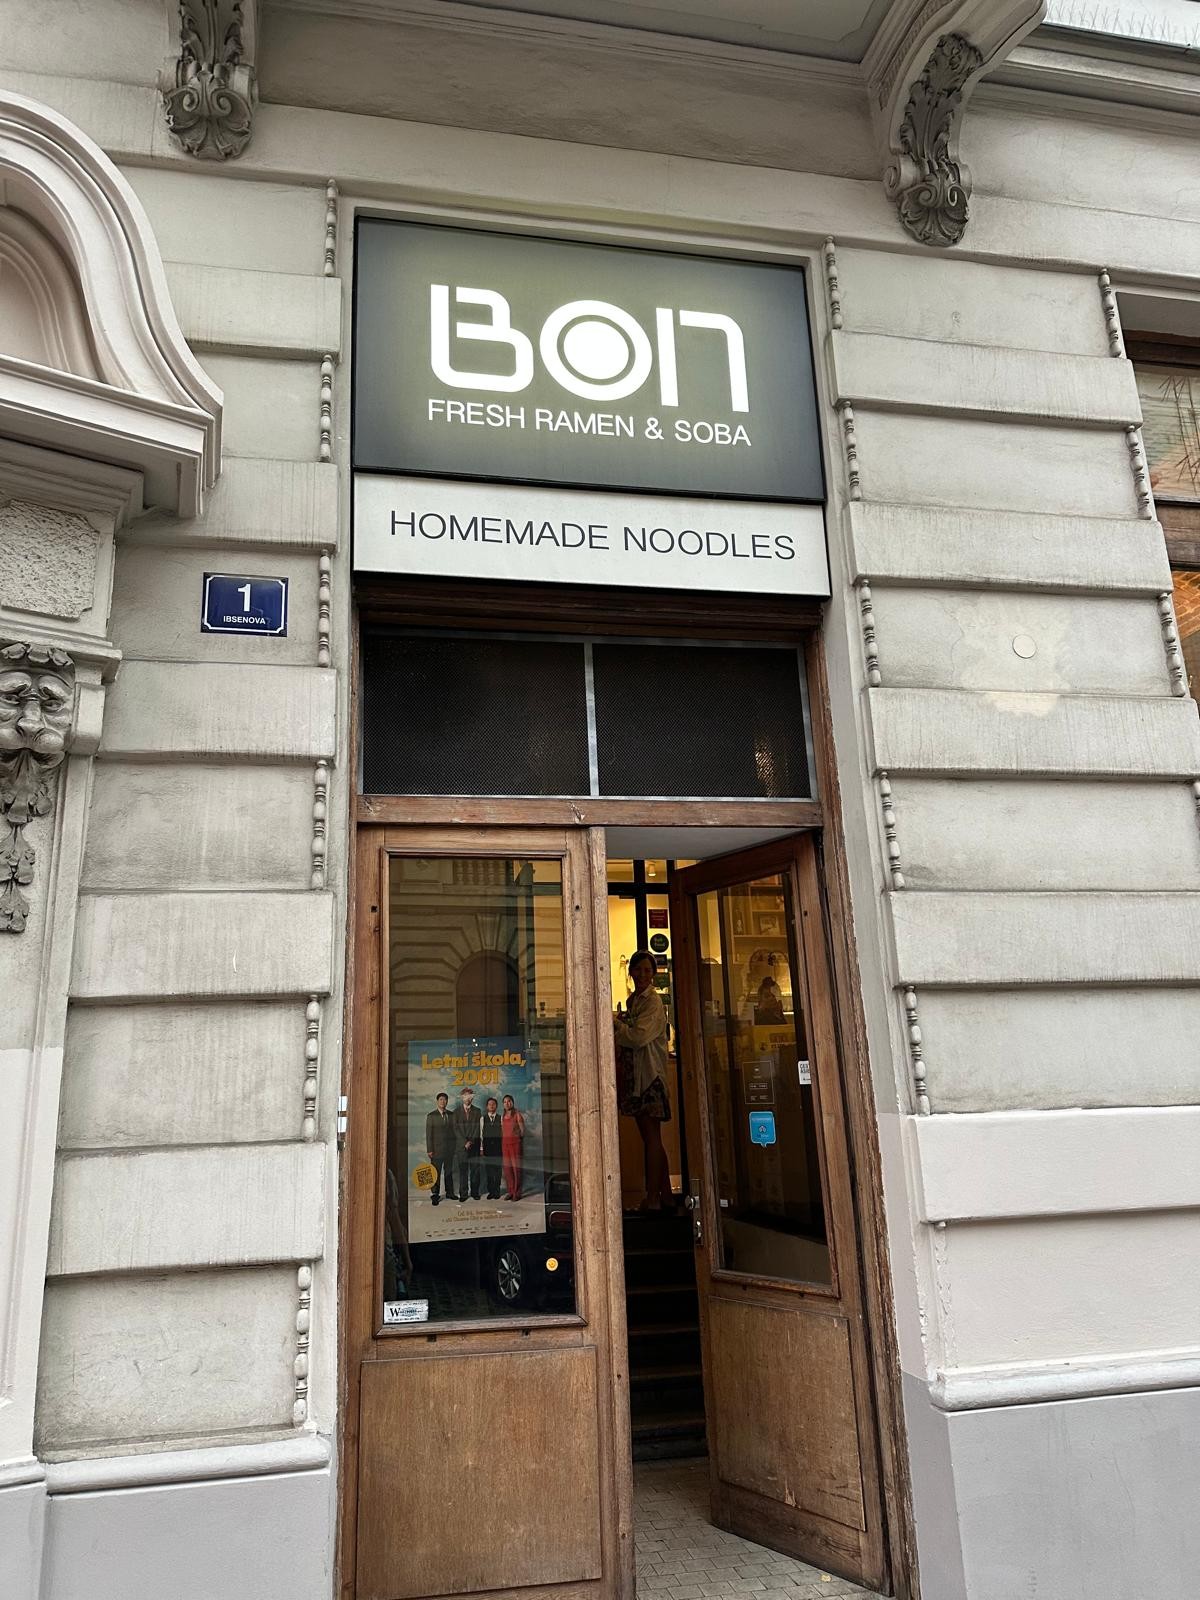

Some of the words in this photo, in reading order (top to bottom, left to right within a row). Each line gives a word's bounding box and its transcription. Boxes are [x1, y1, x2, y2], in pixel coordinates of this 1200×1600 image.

[428, 399, 525, 429] FRESH
[535, 409, 635, 438] RAMEN
[644, 417, 665, 440] &
[674, 420, 752, 447] SOBA
[391, 510, 610, 550] HOMEMADE
[624, 527, 796, 560] NOODLES
[238, 583, 251, 612] 1
[223, 615, 266, 625] IBSENOVA
[421, 1053, 469, 1070] Letní
[472, 1050, 527, 1067] škola,
[452, 1068, 499, 1086] 2001
